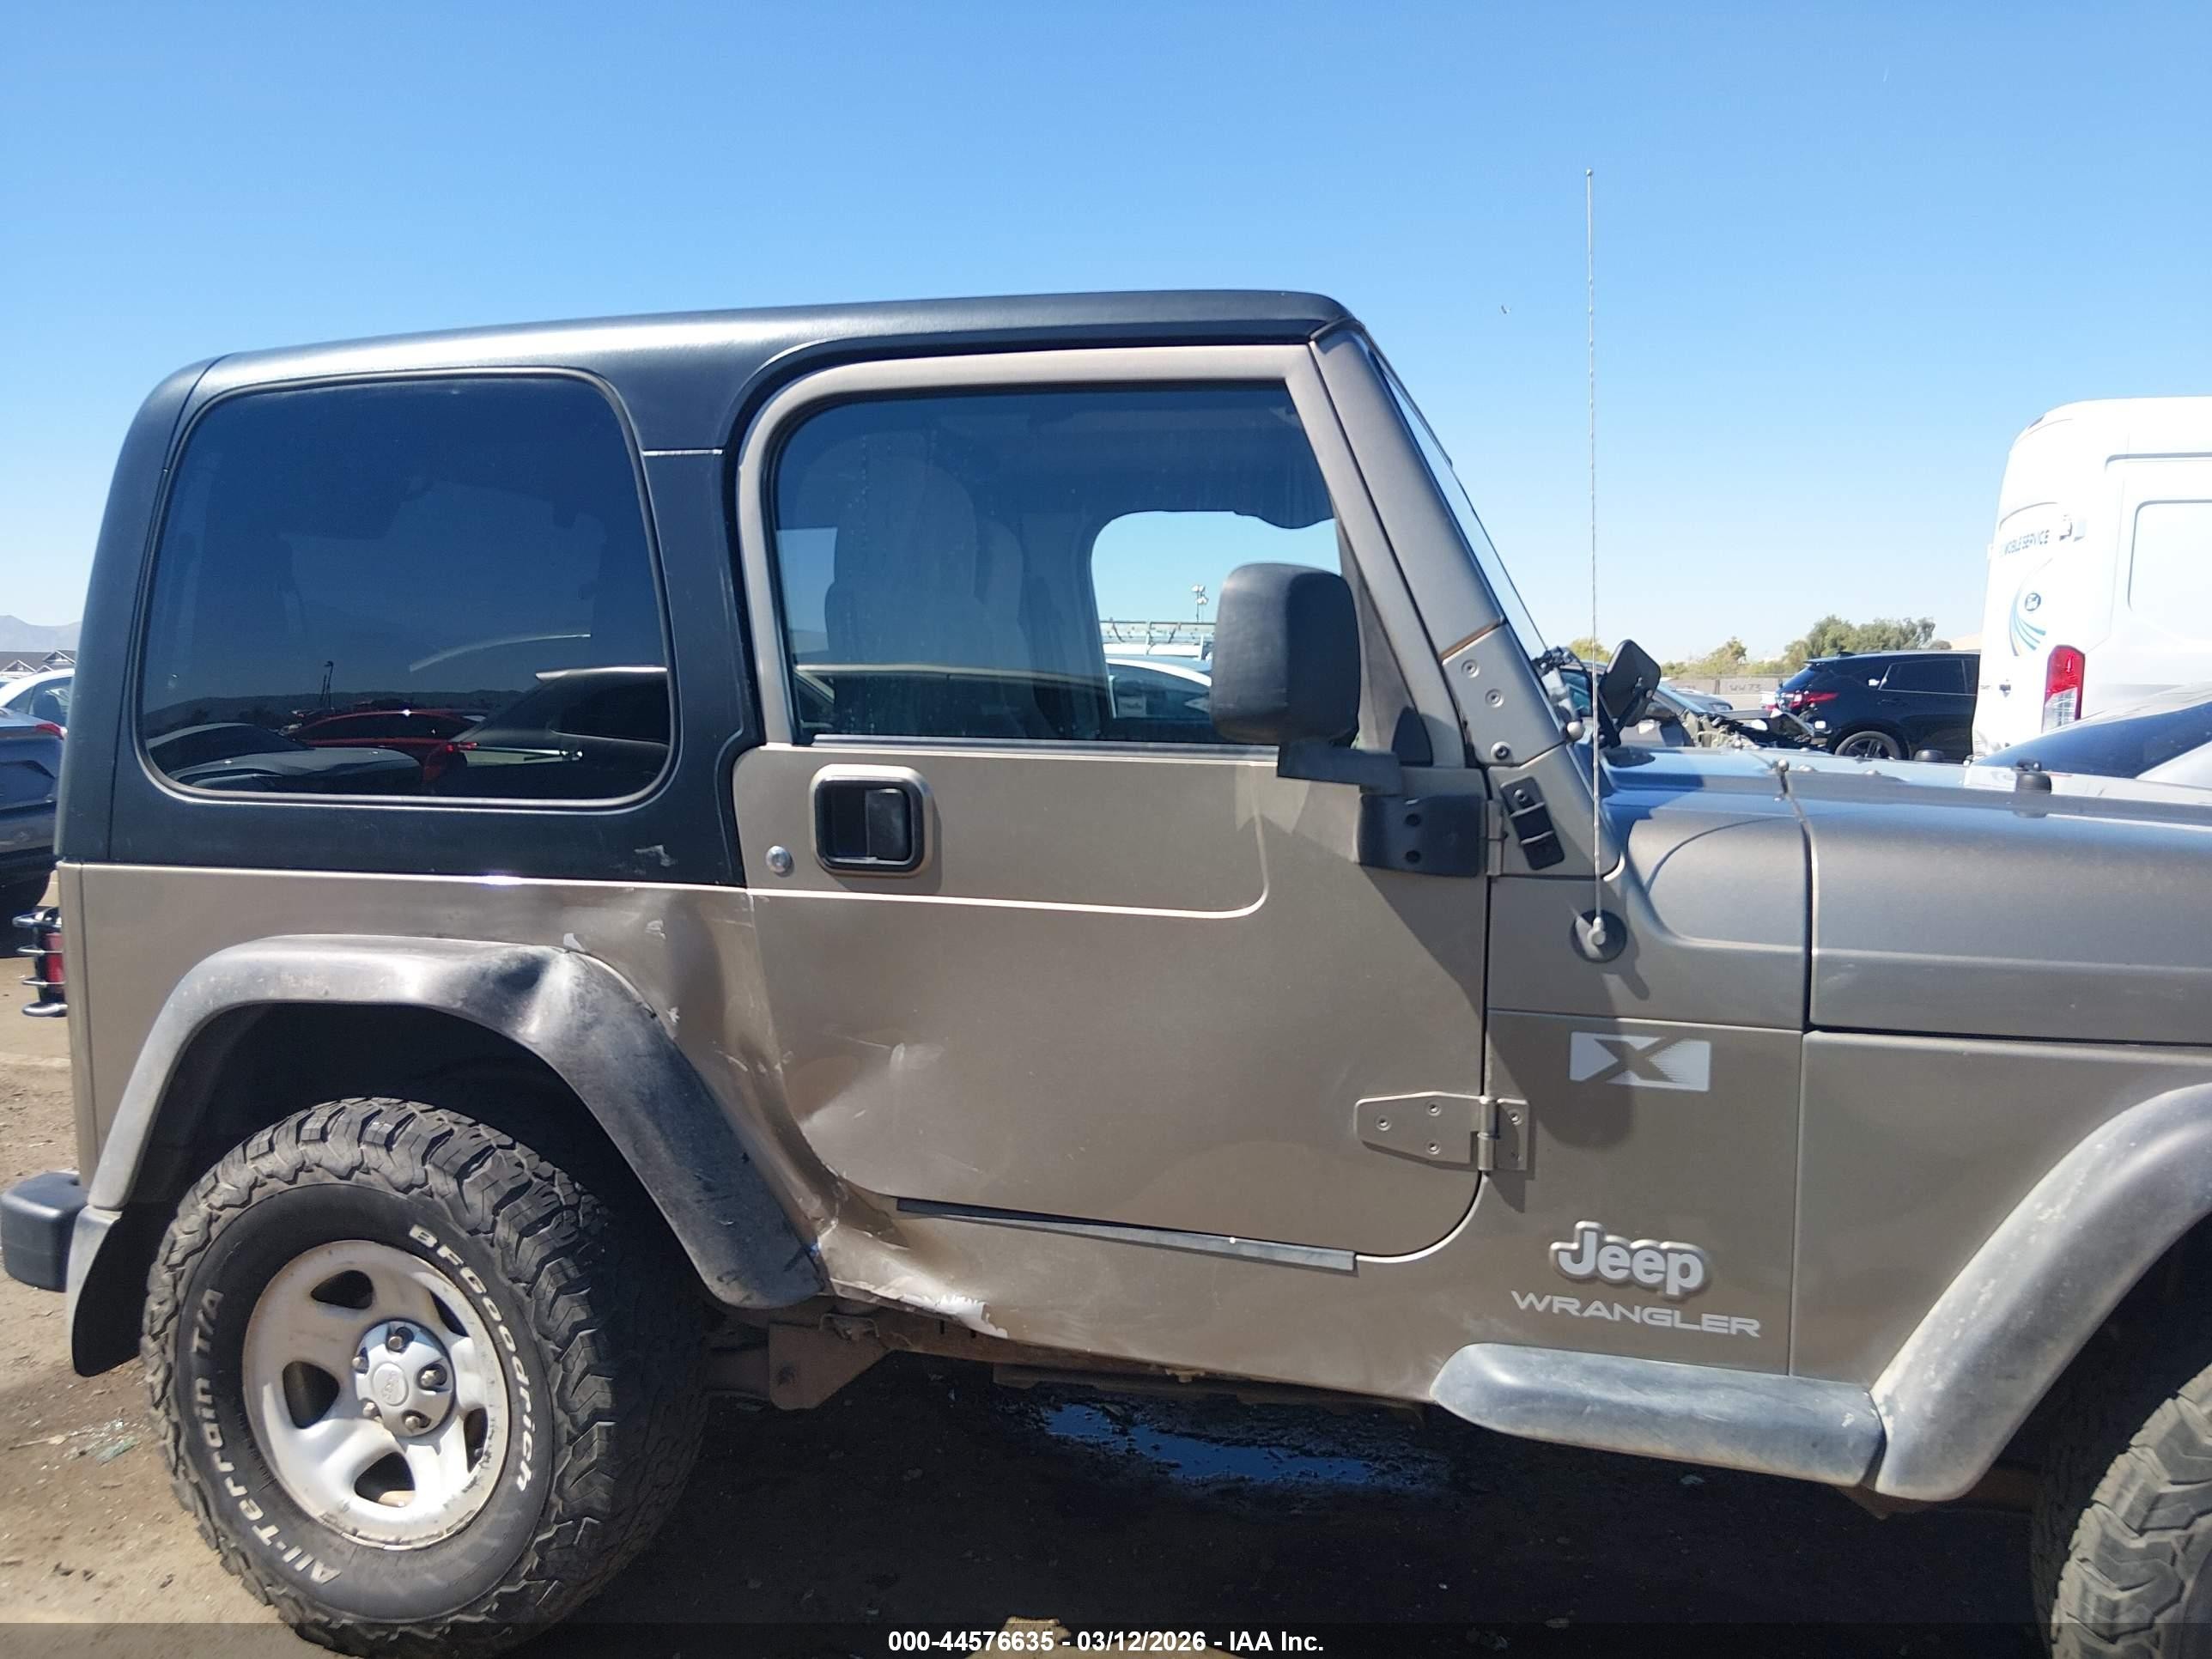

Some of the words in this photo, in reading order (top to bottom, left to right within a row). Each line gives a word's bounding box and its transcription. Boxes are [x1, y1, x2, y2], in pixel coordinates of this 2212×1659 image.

[1577, 1033, 1686, 1088] X
[1557, 1230, 1705, 1296] Jeep
[191, 1289, 224, 1354] T/A
[1510, 1290, 1761, 1338] WRANGLER
[409, 1224, 535, 1492] BFGoodrich
[194, 1376, 343, 1585] All-Terrain
